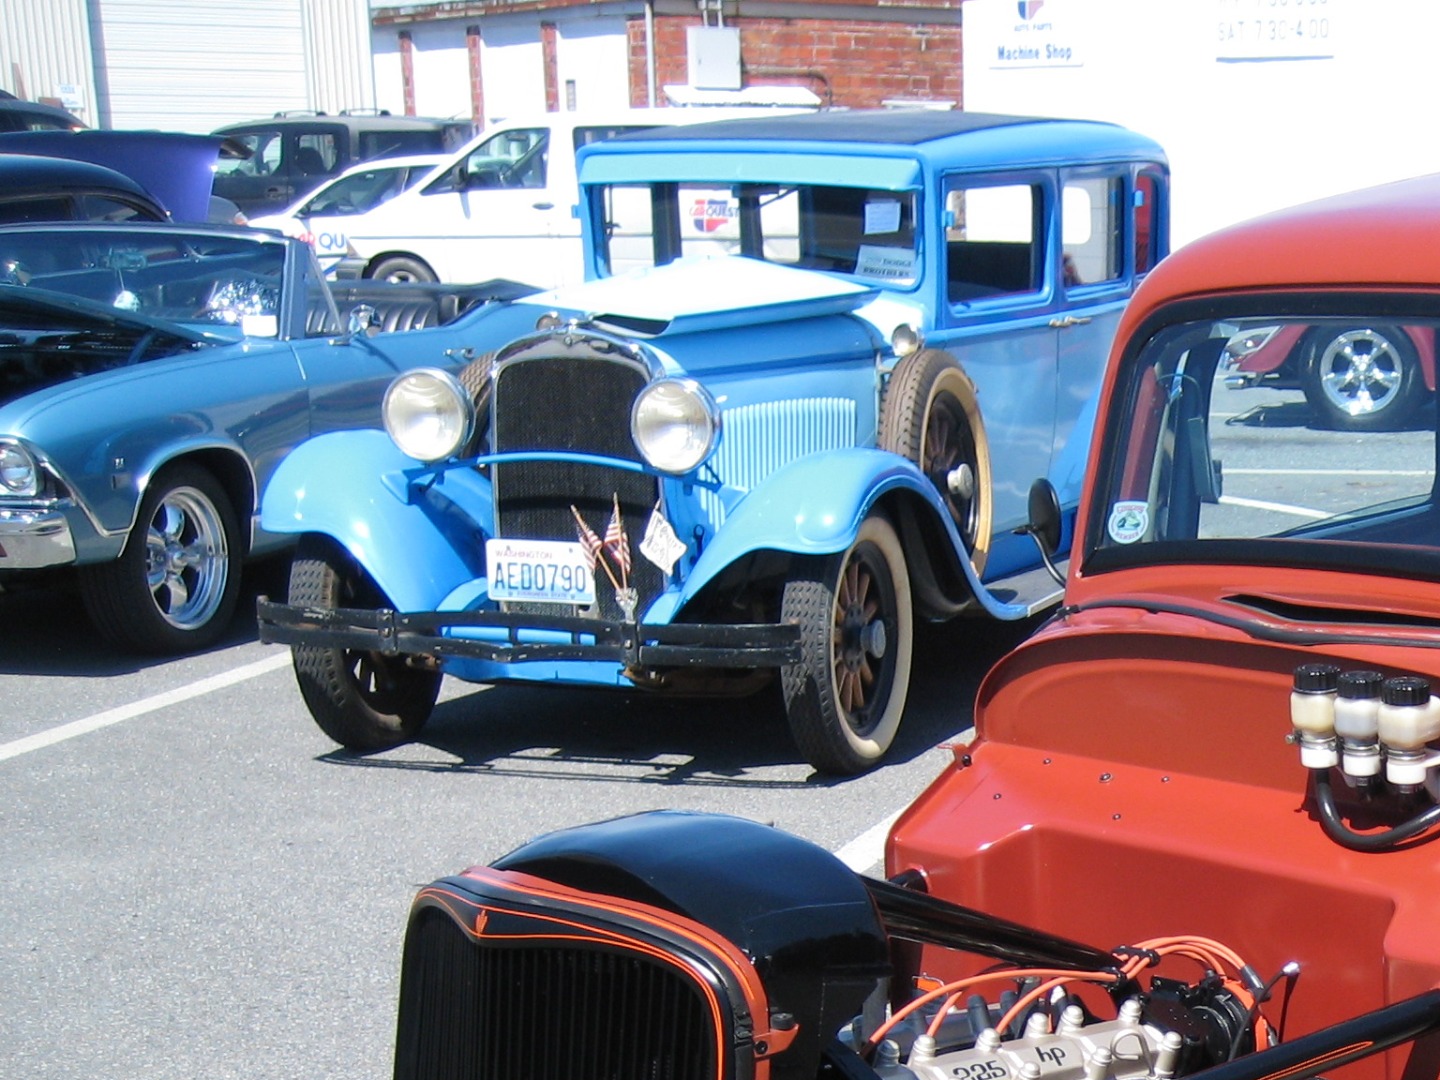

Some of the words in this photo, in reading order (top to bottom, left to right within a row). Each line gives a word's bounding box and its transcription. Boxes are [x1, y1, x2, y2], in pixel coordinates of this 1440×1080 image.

[997, 45, 1040, 61] Machine
[1045, 43, 1072, 62] Shop
[495, 550, 553, 560] WASHINGTON
[494, 562, 586, 593] AED0790
[1035, 1045, 1066, 1067] hp
